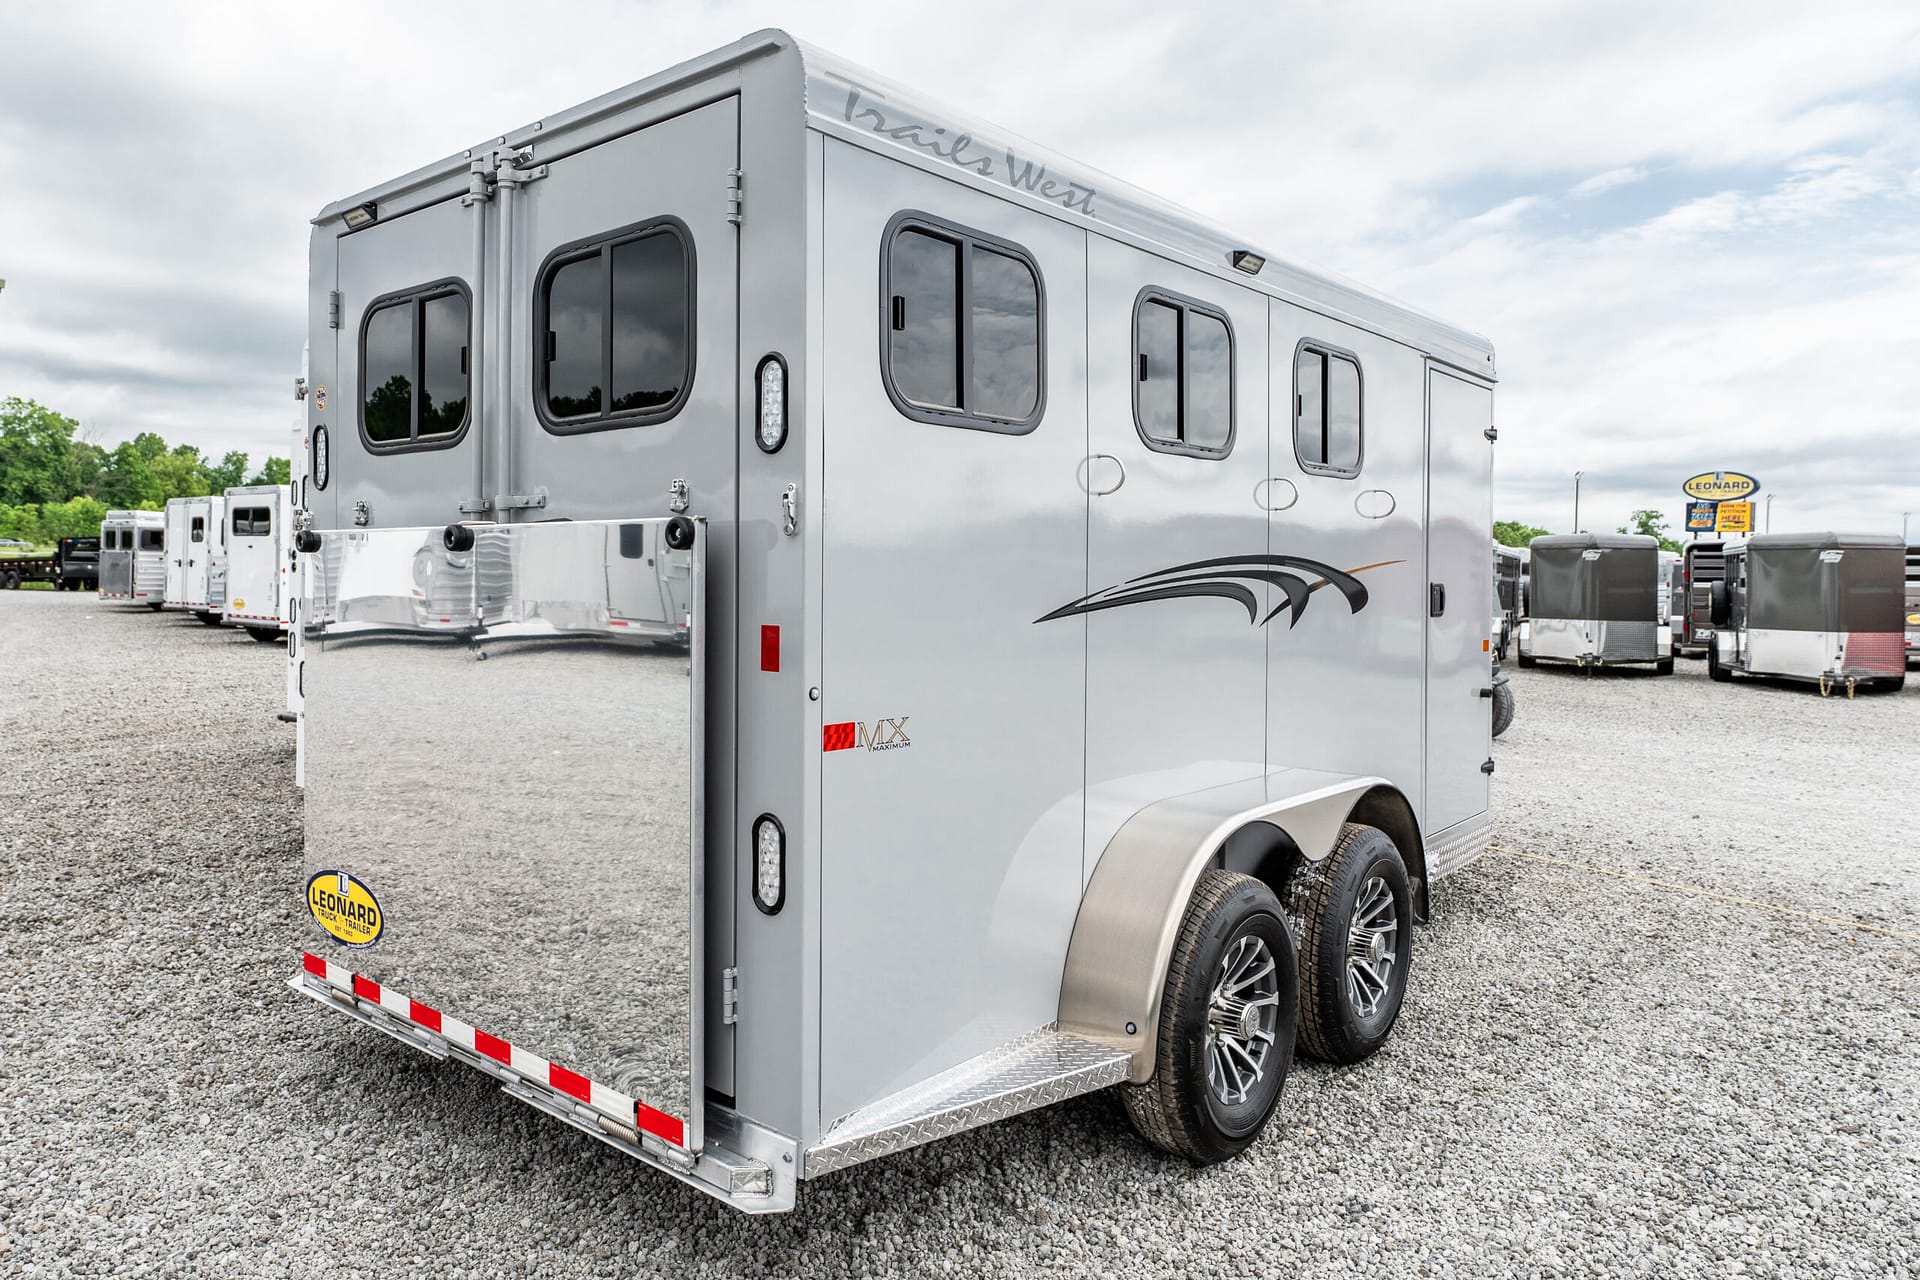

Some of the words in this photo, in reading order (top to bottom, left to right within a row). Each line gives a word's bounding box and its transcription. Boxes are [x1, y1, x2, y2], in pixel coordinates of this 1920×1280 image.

[824, 71, 994, 176] Trails
[1006, 146, 1097, 215] West
[1688, 481, 1750, 490] LEONARD
[856, 716, 910, 752] MX
[872, 742, 911, 752] MAXIMUM
[312, 887, 377, 926] LEONARD
[318, 908, 338, 922] TRUCK
[345, 918, 371, 936] TRAILER
